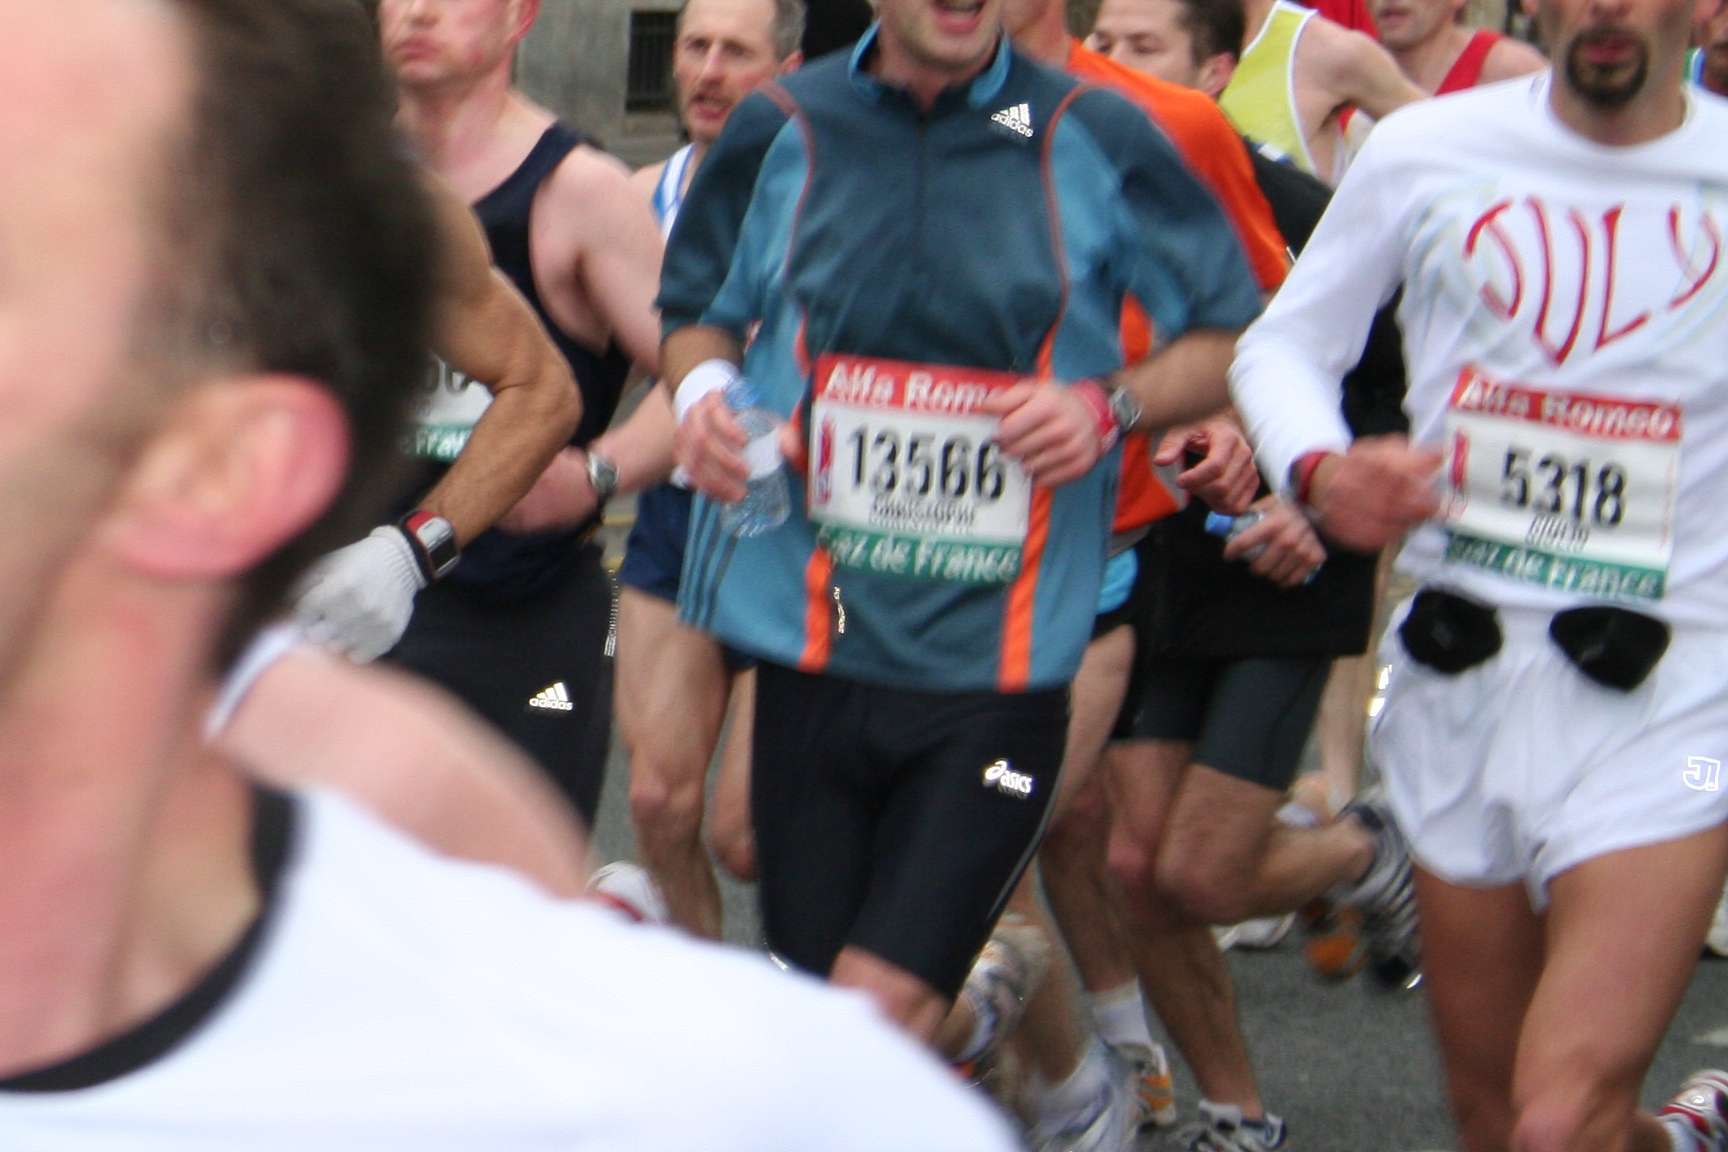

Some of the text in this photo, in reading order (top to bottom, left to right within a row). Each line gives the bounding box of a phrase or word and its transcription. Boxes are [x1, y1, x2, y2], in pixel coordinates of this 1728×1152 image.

[990, 112, 1035, 138] adidas
[824, 361, 895, 405] Alfa
[1458, 377, 1675, 440] Alfa Romeo
[851, 426, 1005, 501] 13566
[1502, 448, 1627, 528] 5318
[869, 532, 911, 575] de
[914, 540, 1020, 582] France
[1501, 547, 1544, 580] de
[1547, 555, 1659, 600] France
[528, 696, 574, 711] adidas
